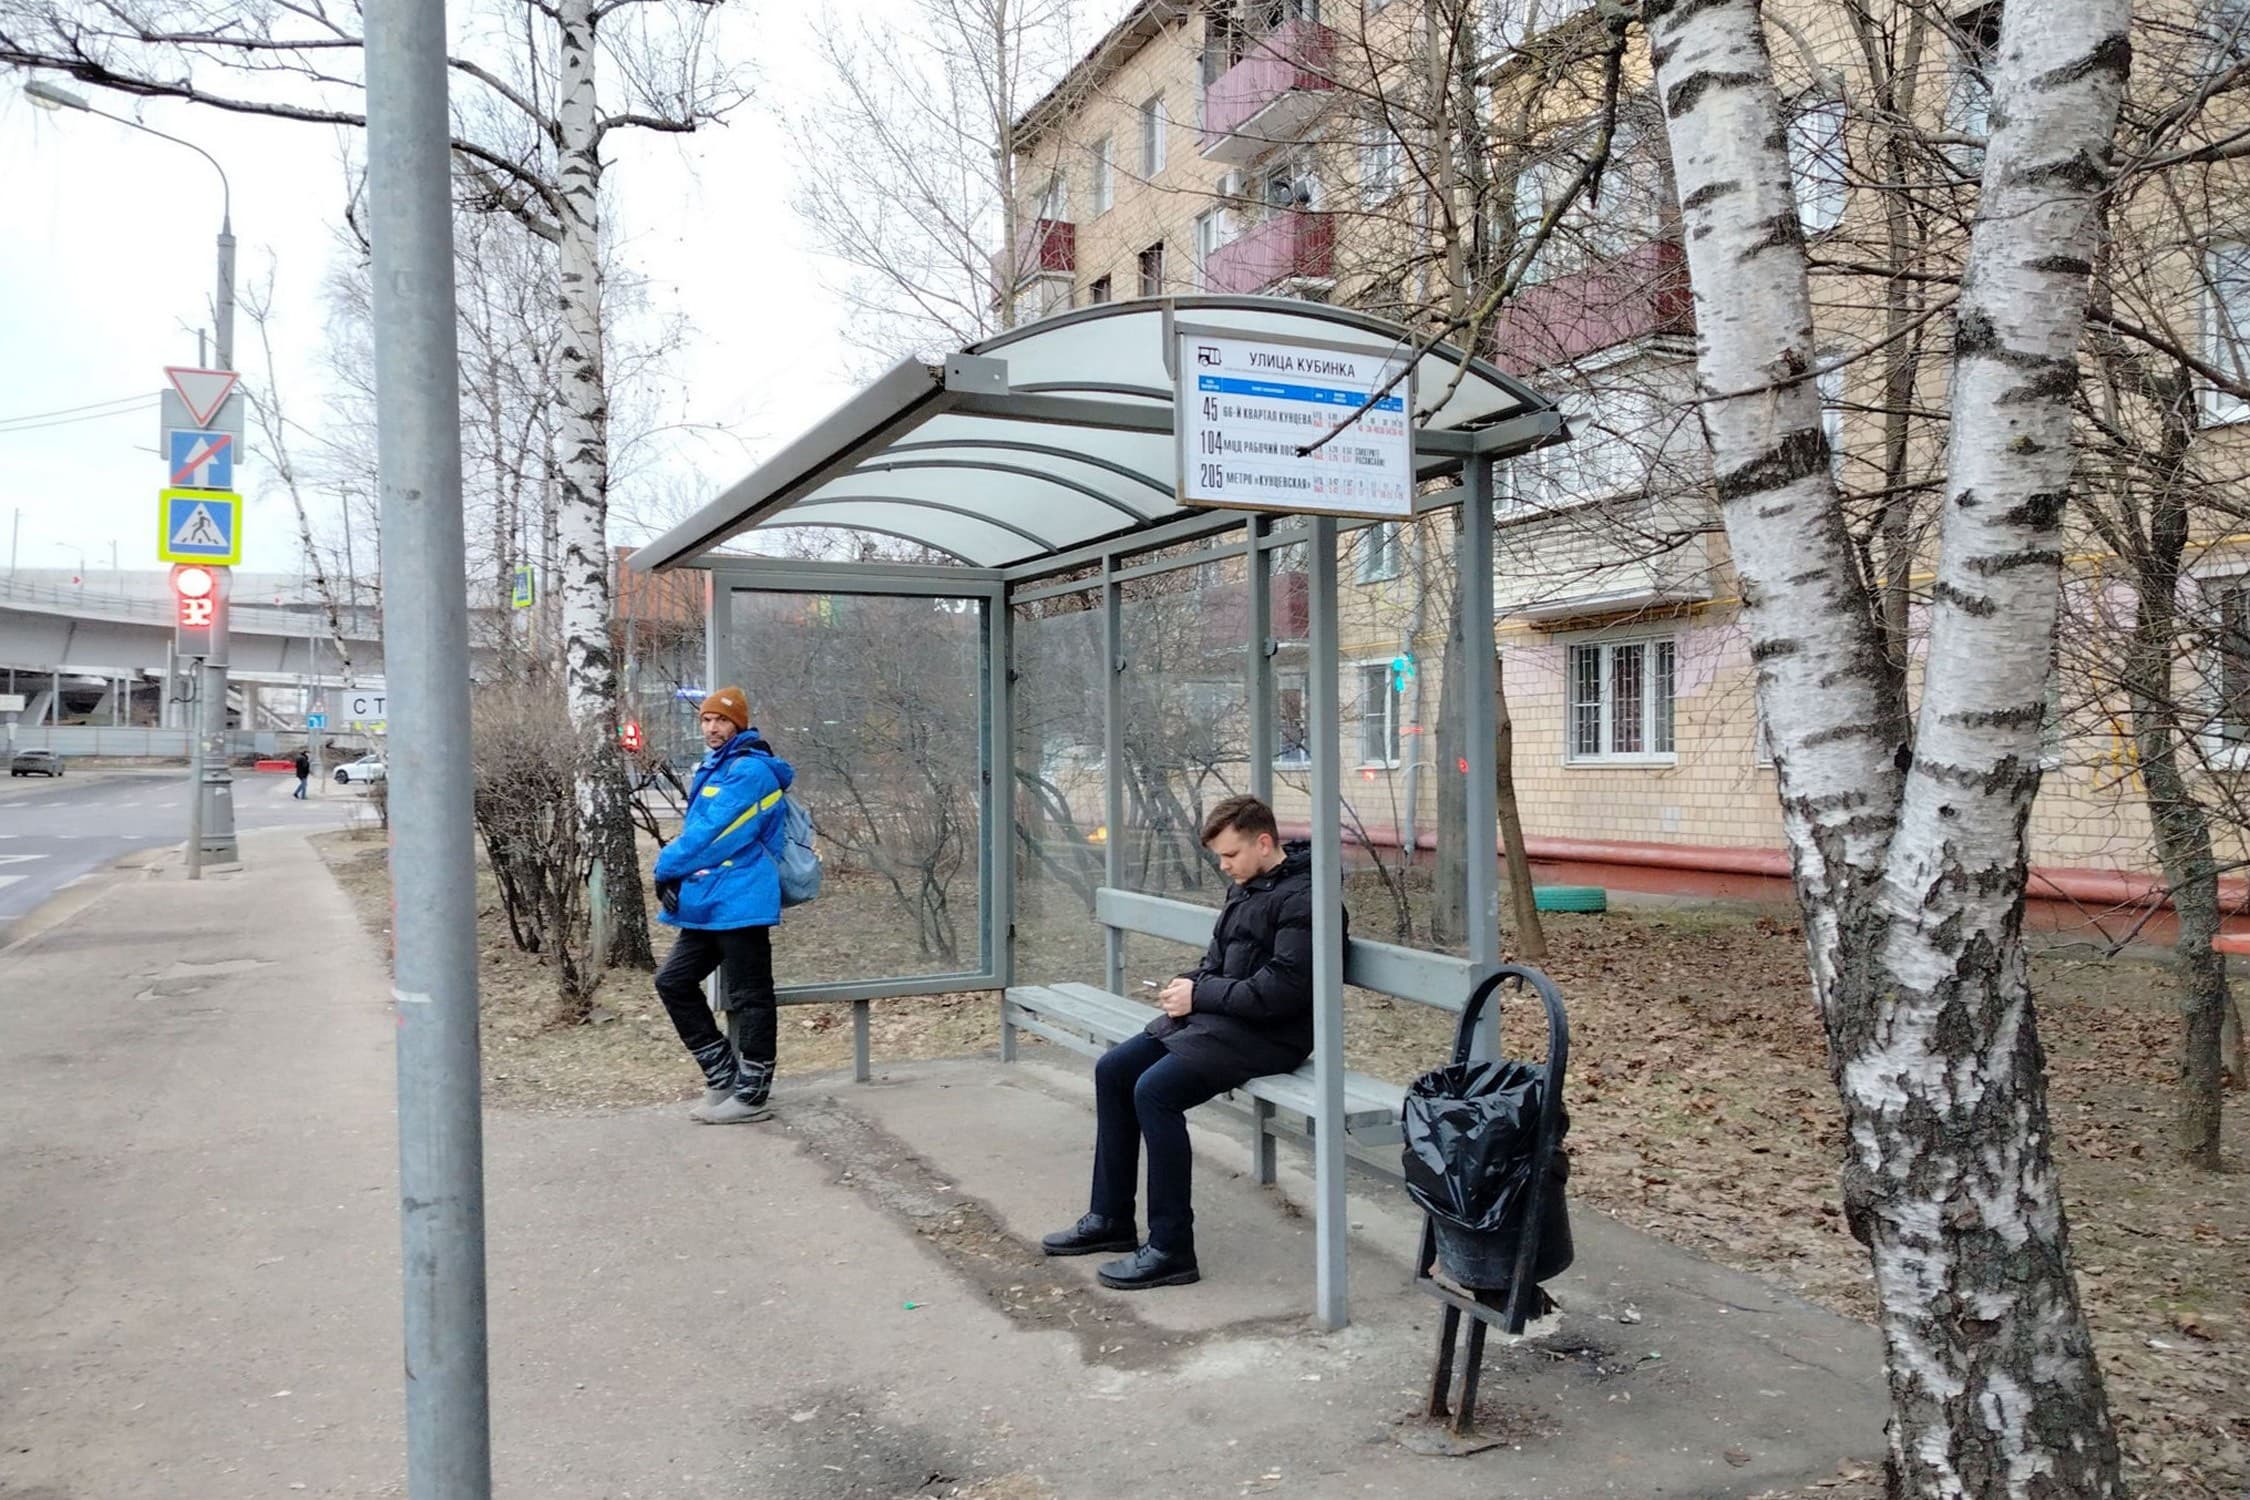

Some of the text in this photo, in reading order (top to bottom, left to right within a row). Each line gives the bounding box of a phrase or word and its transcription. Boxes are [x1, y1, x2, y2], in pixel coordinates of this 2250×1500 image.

[1249, 351, 1356, 378] УЛИЦА КУБИНКА
[1203, 396, 1218, 422] 45
[1243, 407, 1278, 423] КВАРТАЛ
[1200, 429, 1223, 456] 104
[1201, 462, 1223, 489] 205
[1226, 471, 1253, 486] МЕТРО
